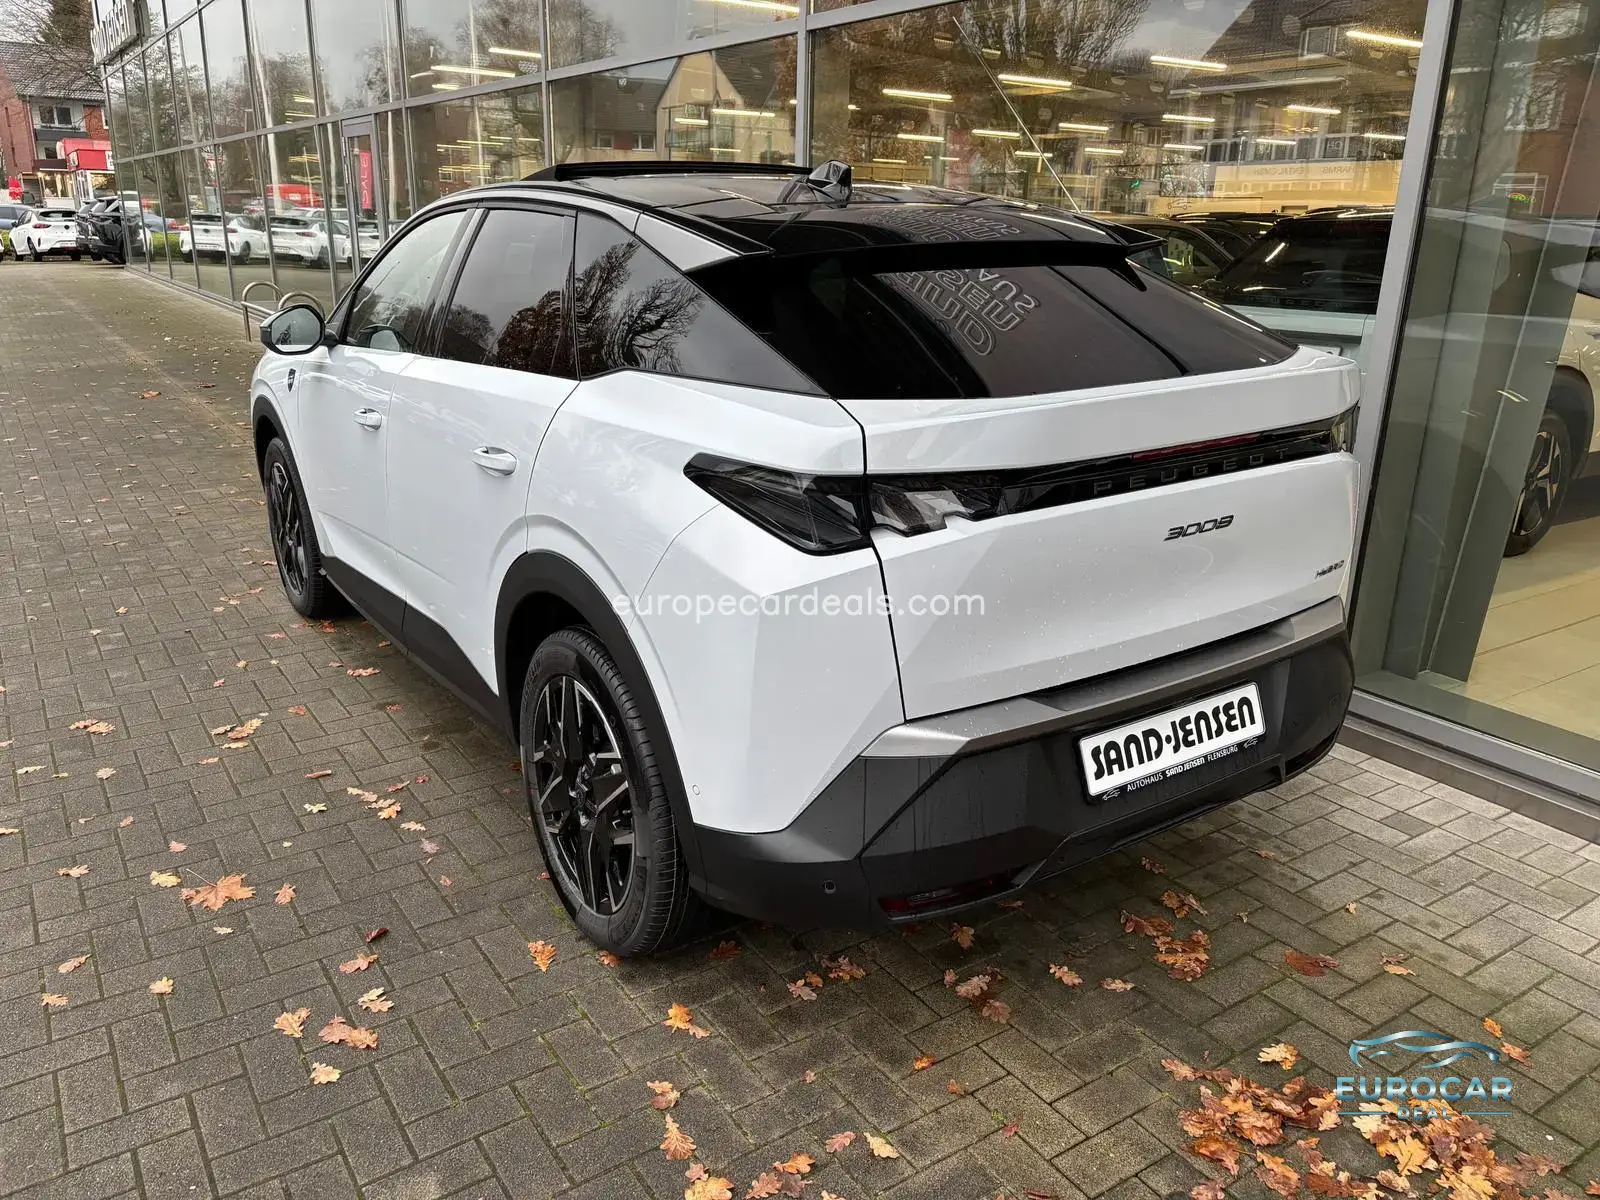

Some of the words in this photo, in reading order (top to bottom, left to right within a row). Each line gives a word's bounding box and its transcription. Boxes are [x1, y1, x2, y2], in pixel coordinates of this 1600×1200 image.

[1093, 448, 1288, 497] PEUGEOT
[1163, 514, 1235, 542] 3008
[1126, 772, 1164, 792] AUTOHAUS
[1165, 765, 1184, 778] SAND
[1183, 757, 1206, 772] JENSEN
[1207, 744, 1239, 763] FLENSBURG
